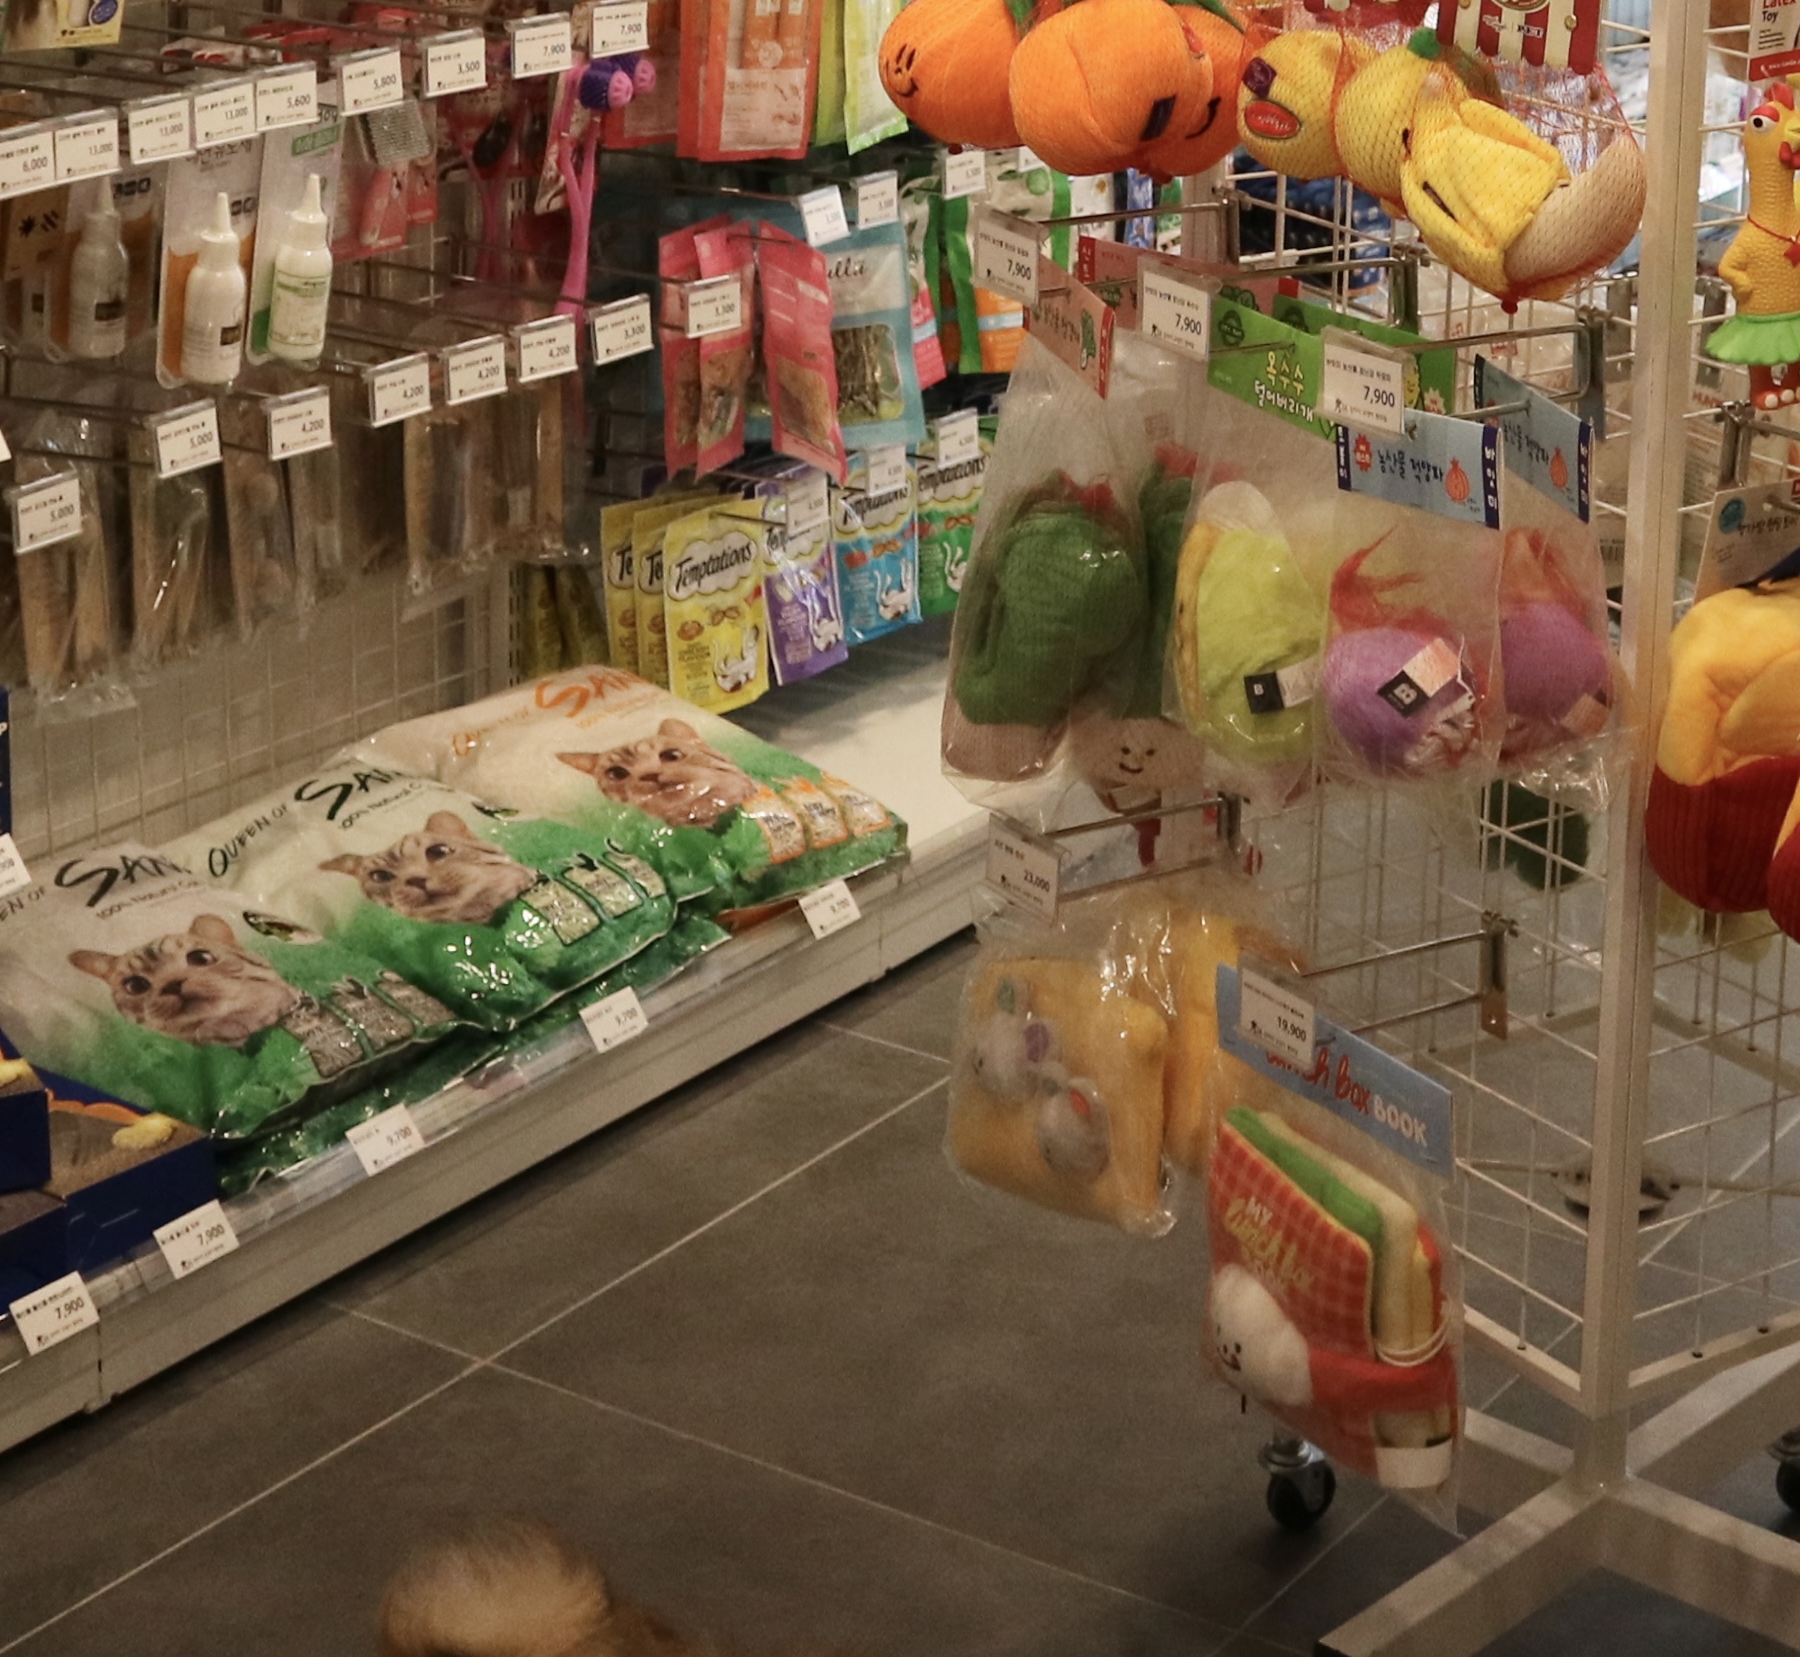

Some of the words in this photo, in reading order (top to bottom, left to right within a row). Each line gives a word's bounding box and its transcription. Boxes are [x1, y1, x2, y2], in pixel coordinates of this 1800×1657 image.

[1265, 349, 1305, 399] 옥수수
[1363, 385, 1396, 407] 7,900
[668, 544, 756, 585] Temptations
[1275, 1014, 1307, 1043] 19,900
[1373, 1097, 1427, 1146] BOOK
